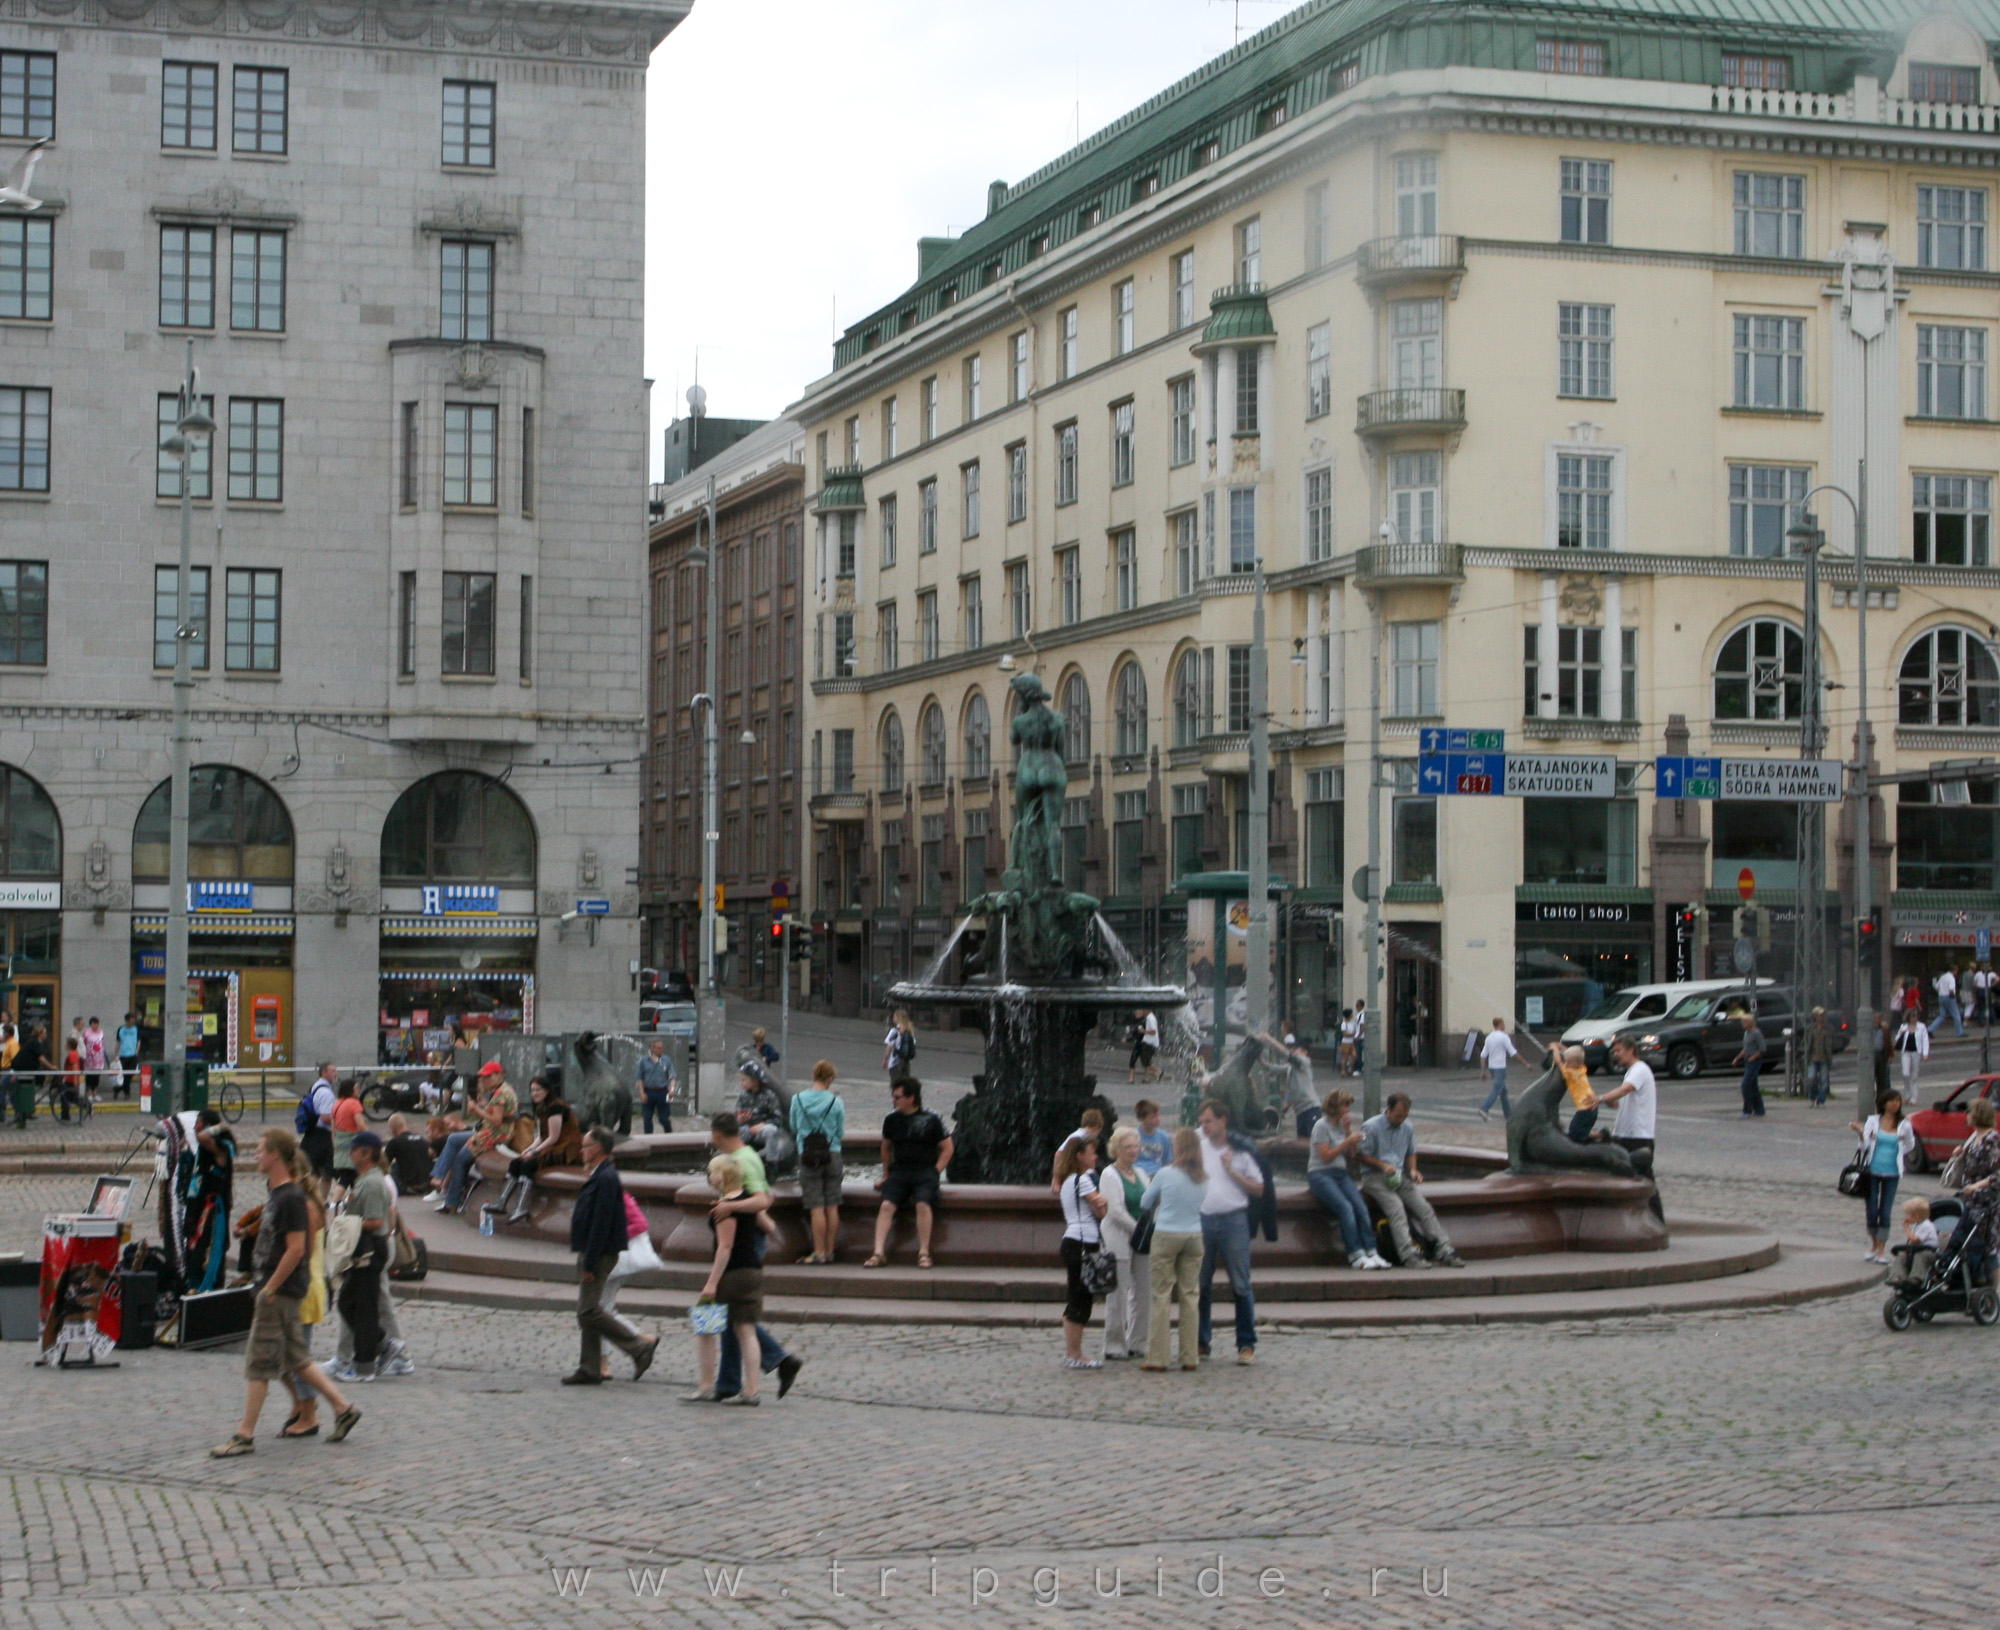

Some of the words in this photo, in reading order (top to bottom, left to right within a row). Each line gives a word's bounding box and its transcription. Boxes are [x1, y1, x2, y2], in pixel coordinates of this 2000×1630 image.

[1470, 731, 1478, 747] E
[1483, 730, 1499, 747] 75
[1508, 759, 1609, 775] KATAJANOKKA
[1725, 762, 1820, 779] ETELÄSATAMA
[1461, 777, 1471, 790] 4
[1508, 777, 1594, 792] SKATUDDEN
[1687, 781, 1696, 794] E
[1700, 782, 1716, 794] 75
[1725, 780, 1771, 795] SÖDRA
[1778, 782, 1837, 796] HAMNEN
